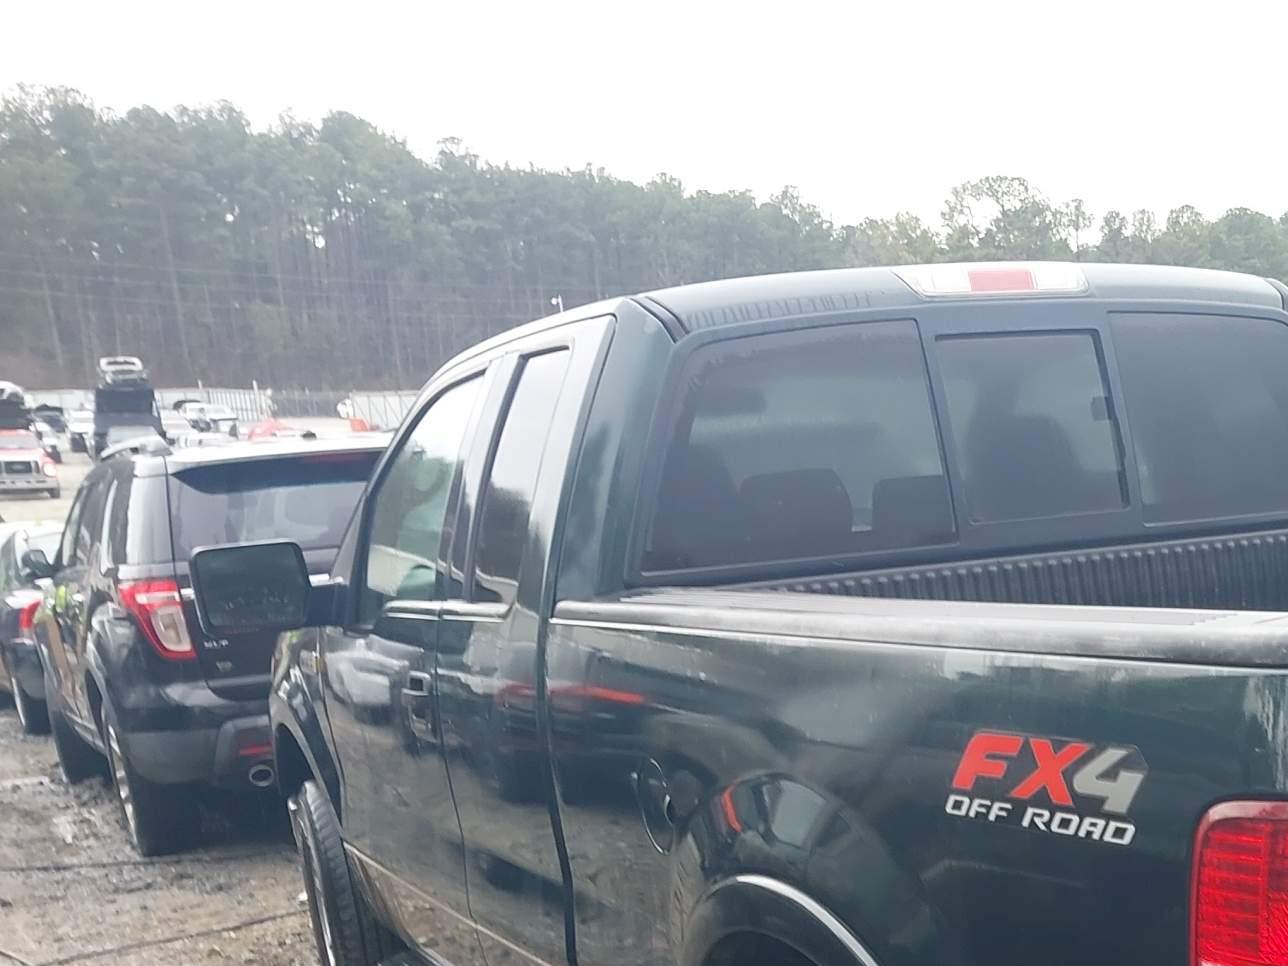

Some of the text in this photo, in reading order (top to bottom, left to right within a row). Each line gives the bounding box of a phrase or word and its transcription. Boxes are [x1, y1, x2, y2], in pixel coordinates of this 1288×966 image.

[952, 731, 1146, 815] FX4
[945, 794, 1136, 846] OFF ROAD
